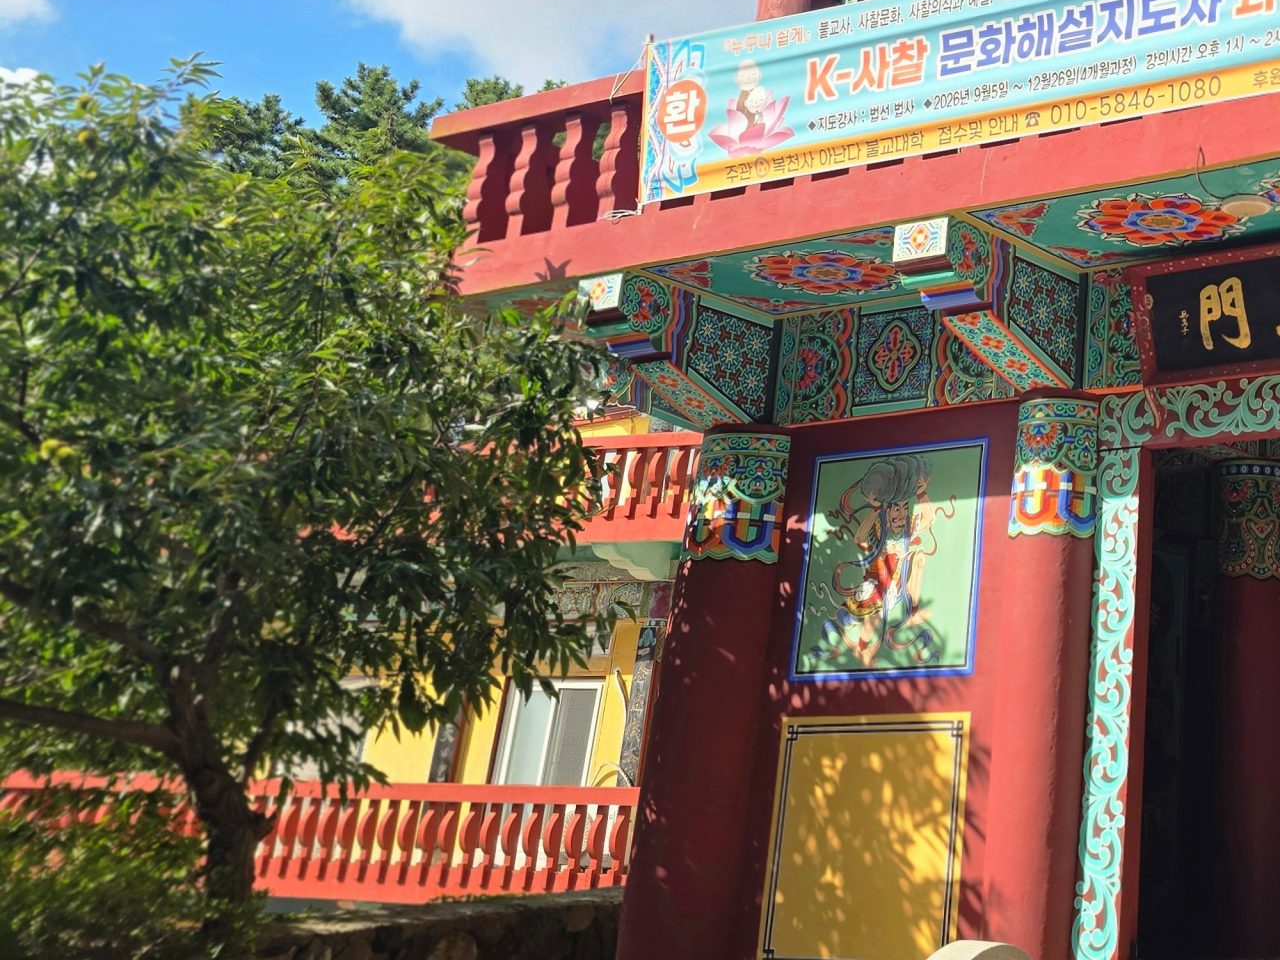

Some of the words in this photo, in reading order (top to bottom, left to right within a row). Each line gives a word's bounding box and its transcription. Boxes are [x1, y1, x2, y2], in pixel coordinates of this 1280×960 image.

[806, 37, 929, 102] K-사찰
[869, 105, 890, 123] 법선
[894, 98, 915, 117] 법사
[933, 88, 970, 111] 2026년
[1146, 44, 1192, 70] 강의시간
[1197, 40, 1220, 60] 오후
[1226, 35, 1244, 54] 1시
[663, 88, 699, 134] 환
[724, 162, 753, 183] 주관
[772, 150, 814, 172] 복천사
[819, 142, 861, 166] 아난다
[865, 130, 925, 158] 불교대학
[988, 113, 1018, 137] 안내
[1050, 75, 1222, 125] 010-5846-1080
